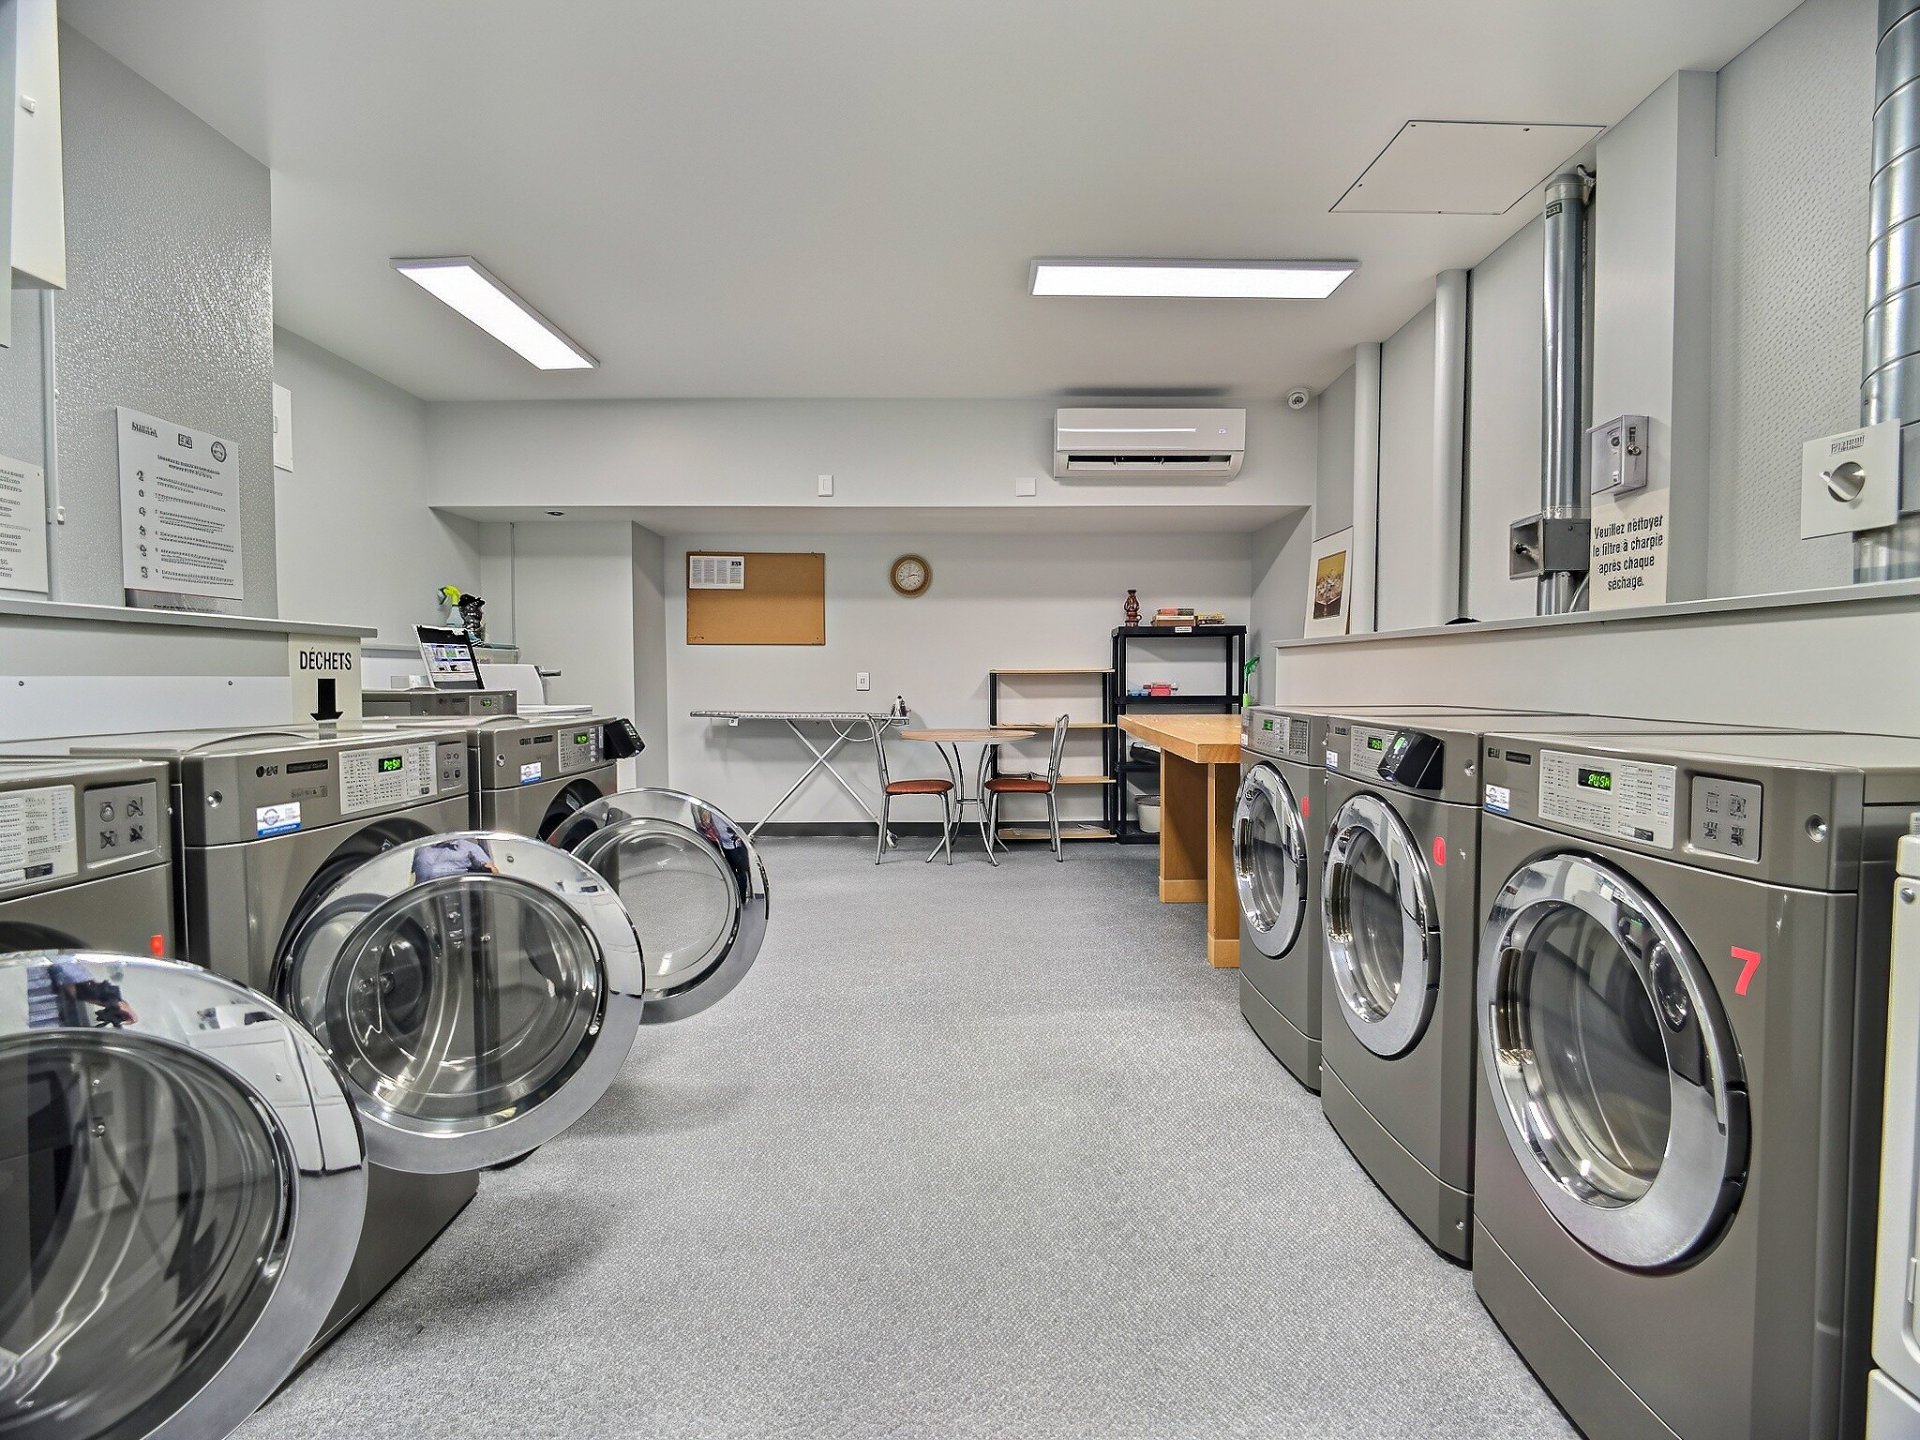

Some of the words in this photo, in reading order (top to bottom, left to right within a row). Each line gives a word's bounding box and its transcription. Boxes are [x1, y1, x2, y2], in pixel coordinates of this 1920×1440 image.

[1594, 523, 1625, 539] Veuillez
[1593, 545, 1600, 557] le
[1602, 541, 1620, 556] filtre
[1623, 539, 1628, 552] à
[1630, 533, 1663, 550] charpie
[1598, 560, 1621, 575] après
[1623, 555, 1655, 570] chaque
[300, 646, 352, 670] DÉCHETS
[1731, 945, 1761, 996] 7
